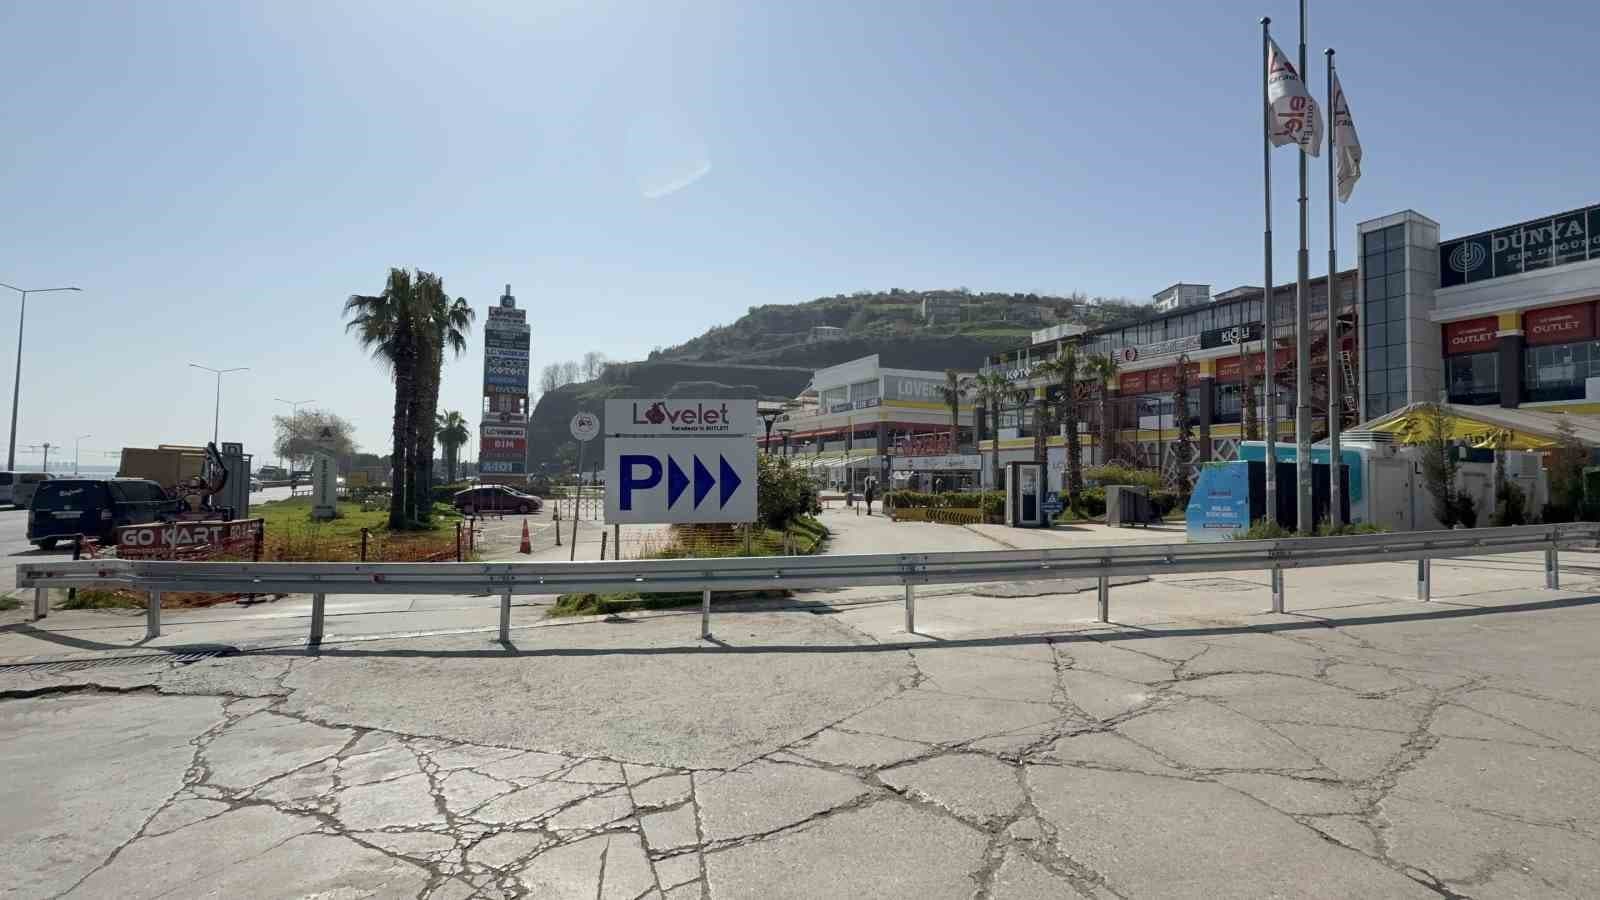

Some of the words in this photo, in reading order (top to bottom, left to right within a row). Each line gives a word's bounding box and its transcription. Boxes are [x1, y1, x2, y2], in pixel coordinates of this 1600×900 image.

[1493, 219, 1585, 253] DÜNYA
[1532, 321, 1581, 334] OUTLET
[1452, 333, 1493, 345] OUTLET
[1006, 367, 1031, 379] KOTO
[633, 401, 729, 424] Lovelet
[619, 455, 663, 510] P
[122, 528, 155, 546] GO
[161, 526, 224, 545] KART
